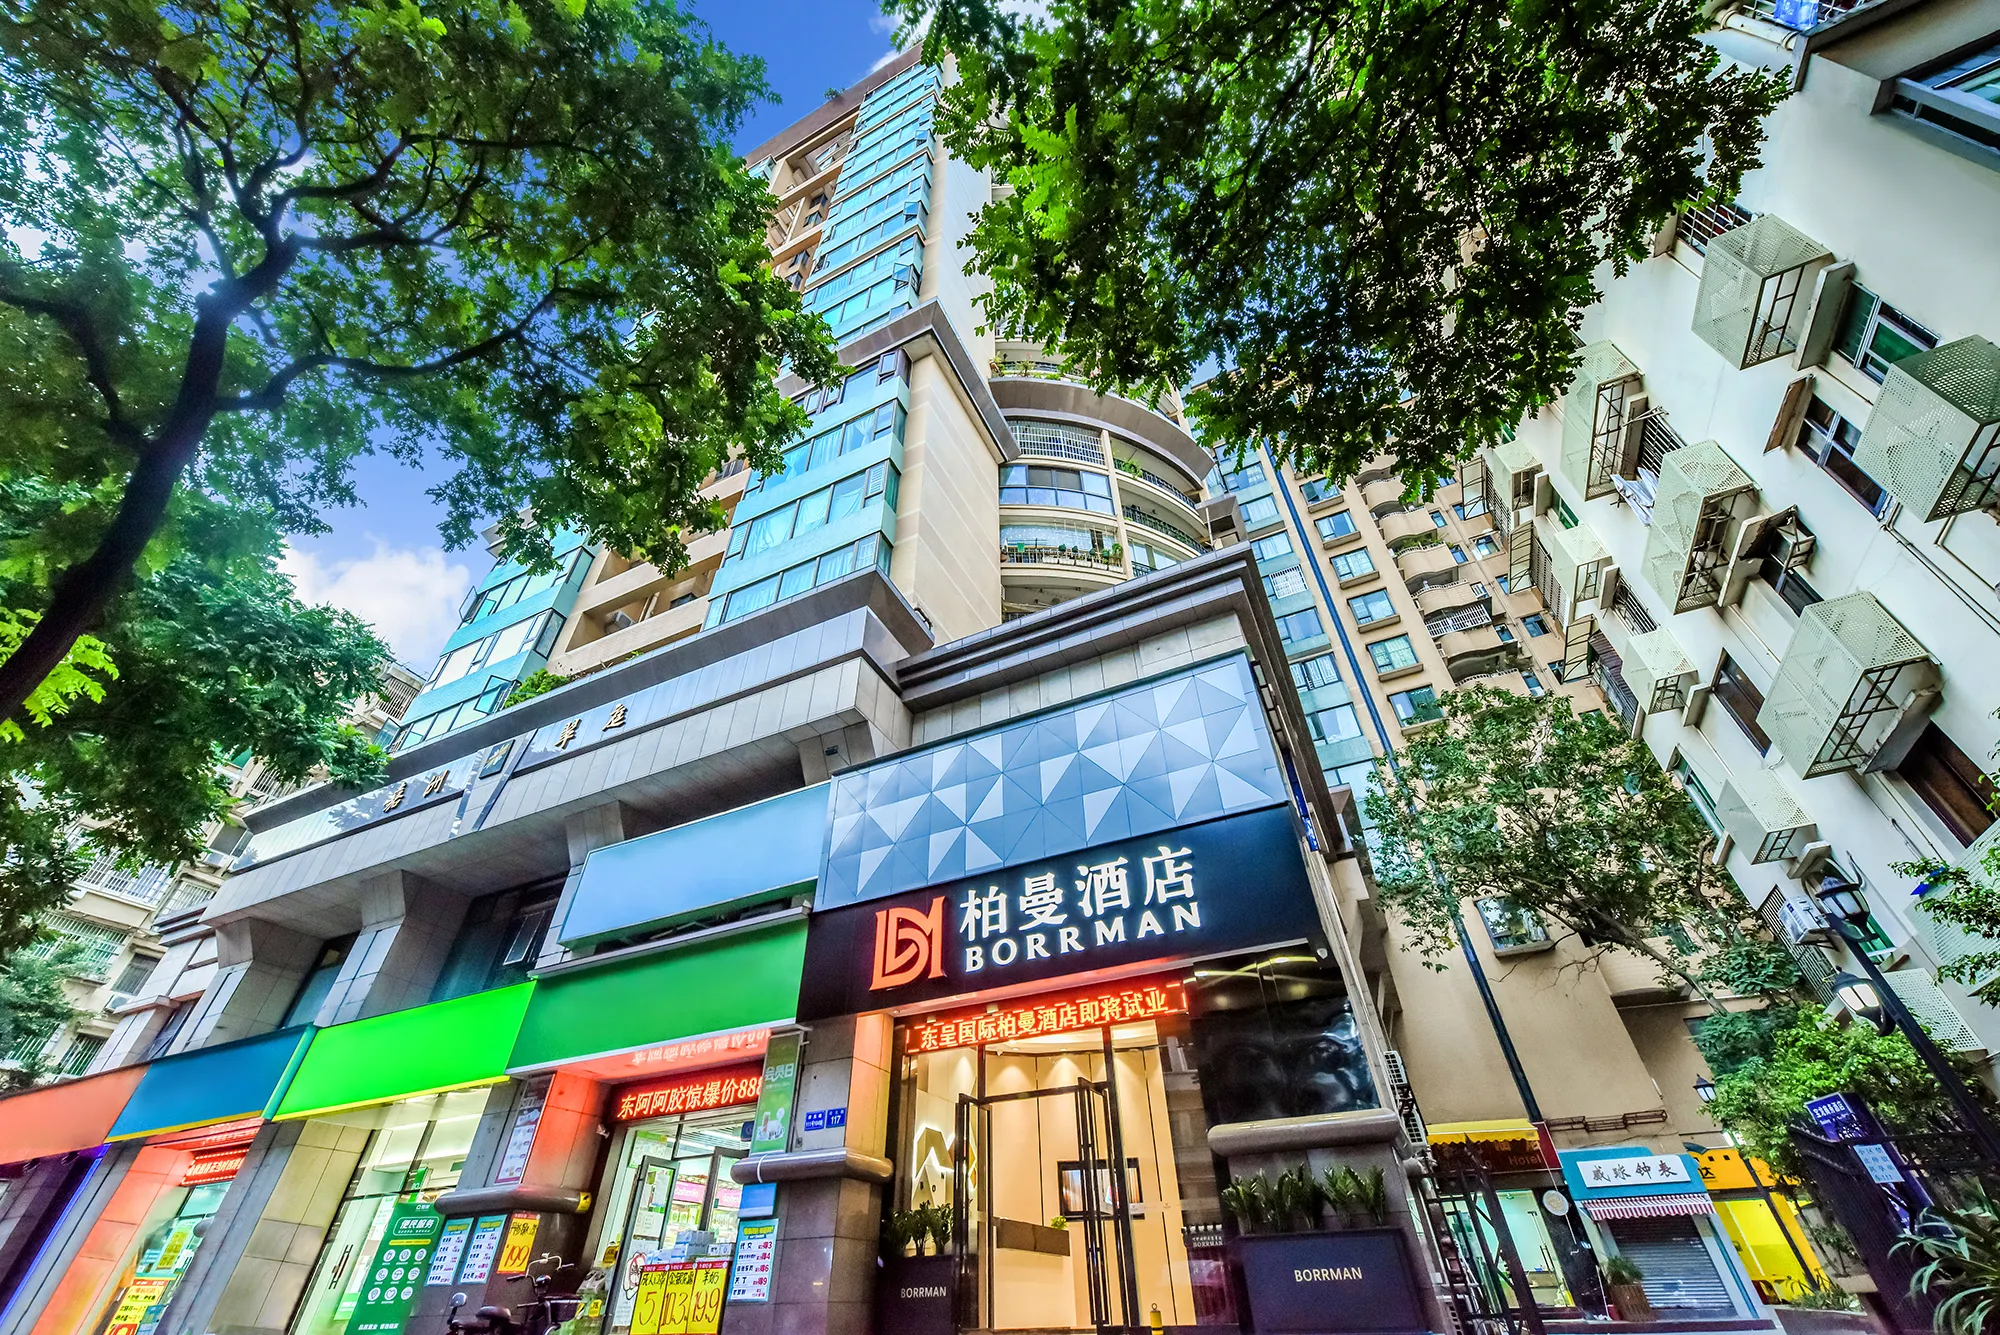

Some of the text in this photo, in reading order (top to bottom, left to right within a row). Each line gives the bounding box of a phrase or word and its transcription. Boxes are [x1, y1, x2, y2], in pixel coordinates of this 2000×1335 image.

[959, 845, 1196, 942] 柏曼酒店
[964, 901, 1202, 973] BORRMAN
[920, 990, 1168, 1050] 东呈国际柏曼酒店即将试业
[765, 1063, 795, 1082] 会员日
[830, 1115, 842, 1125] 117
[1509, 1154, 1542, 1166] Hotel
[1293, 1267, 1363, 1282] BORRMAN
[901, 1286, 947, 1299] BORRMAN
